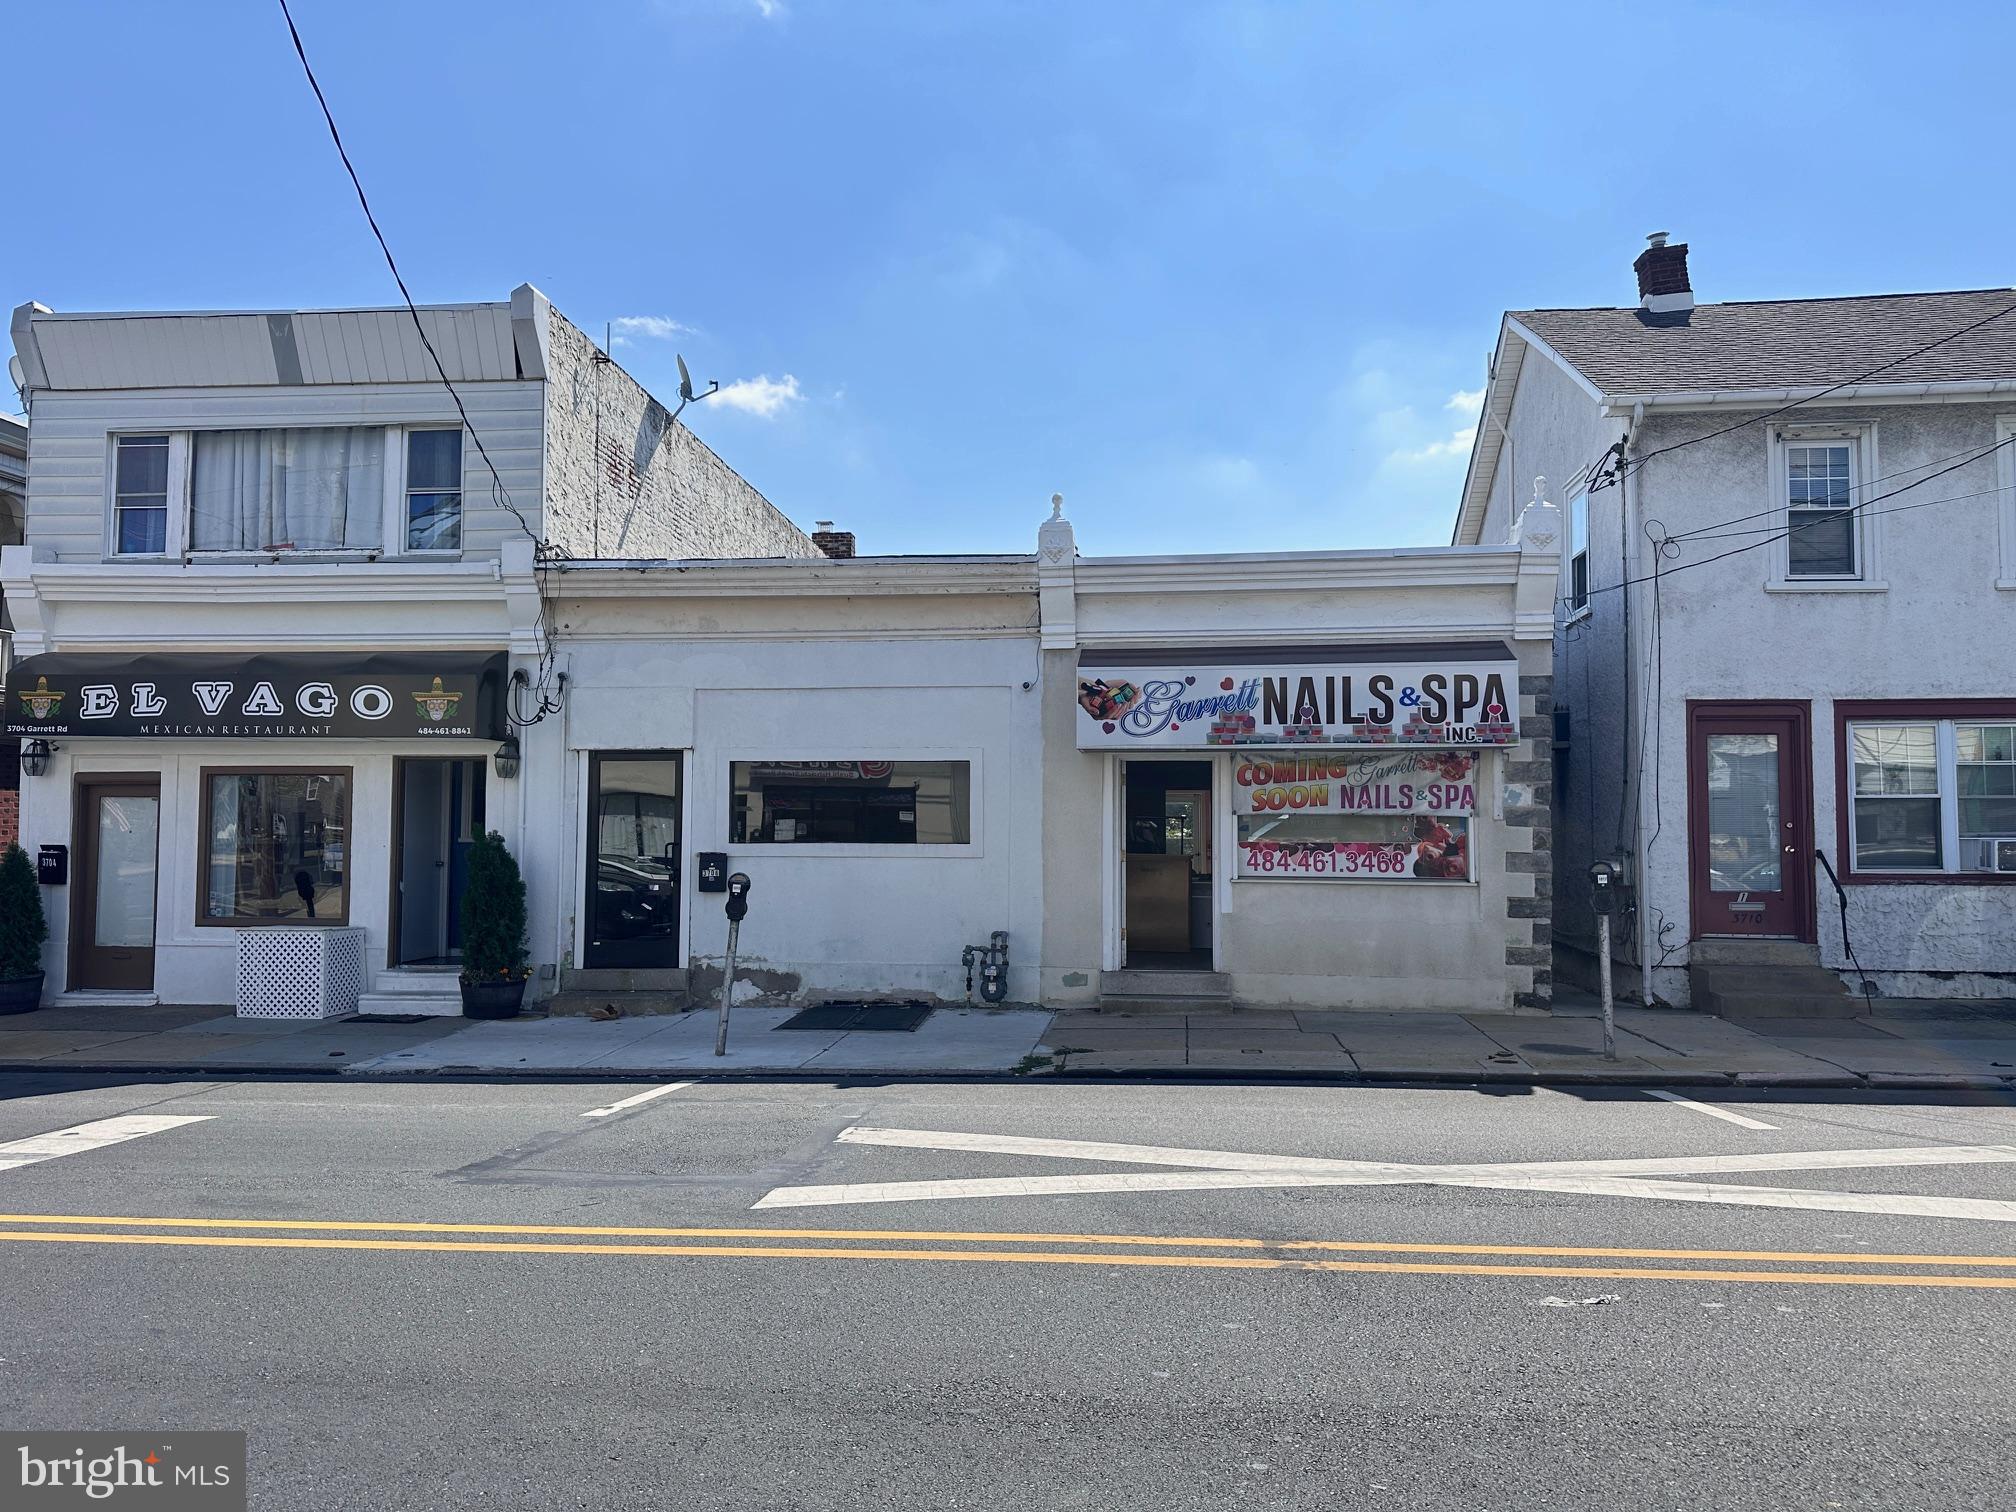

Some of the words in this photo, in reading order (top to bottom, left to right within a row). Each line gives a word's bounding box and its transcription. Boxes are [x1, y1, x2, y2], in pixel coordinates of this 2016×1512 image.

[80, 683, 167, 720] EL
[192, 682, 393, 720] VAGO
[1120, 677, 1261, 738] Garrett
[1263, 674, 1395, 726] NAILS
[1398, 686, 1422, 708] &
[1421, 673, 1510, 725] SPA
[26, 725, 55, 733] Garrett
[57, 725, 68, 733] Rd
[140, 725, 215, 734] MEXICAN
[222, 725, 331, 735] RESTAURANT
[418, 727, 471, 735] 484-461-8841
[1237, 756, 1347, 786] COMING
[1346, 753, 1419, 788] Garrett
[1252, 784, 1329, 812] SOON
[1340, 784, 1413, 810] NAILS
[1415, 789, 1428, 801] &
[1428, 784, 1475, 810] SPA
[42, 858, 57, 867] 3704
[1246, 850, 1406, 873] 484.461.3468
